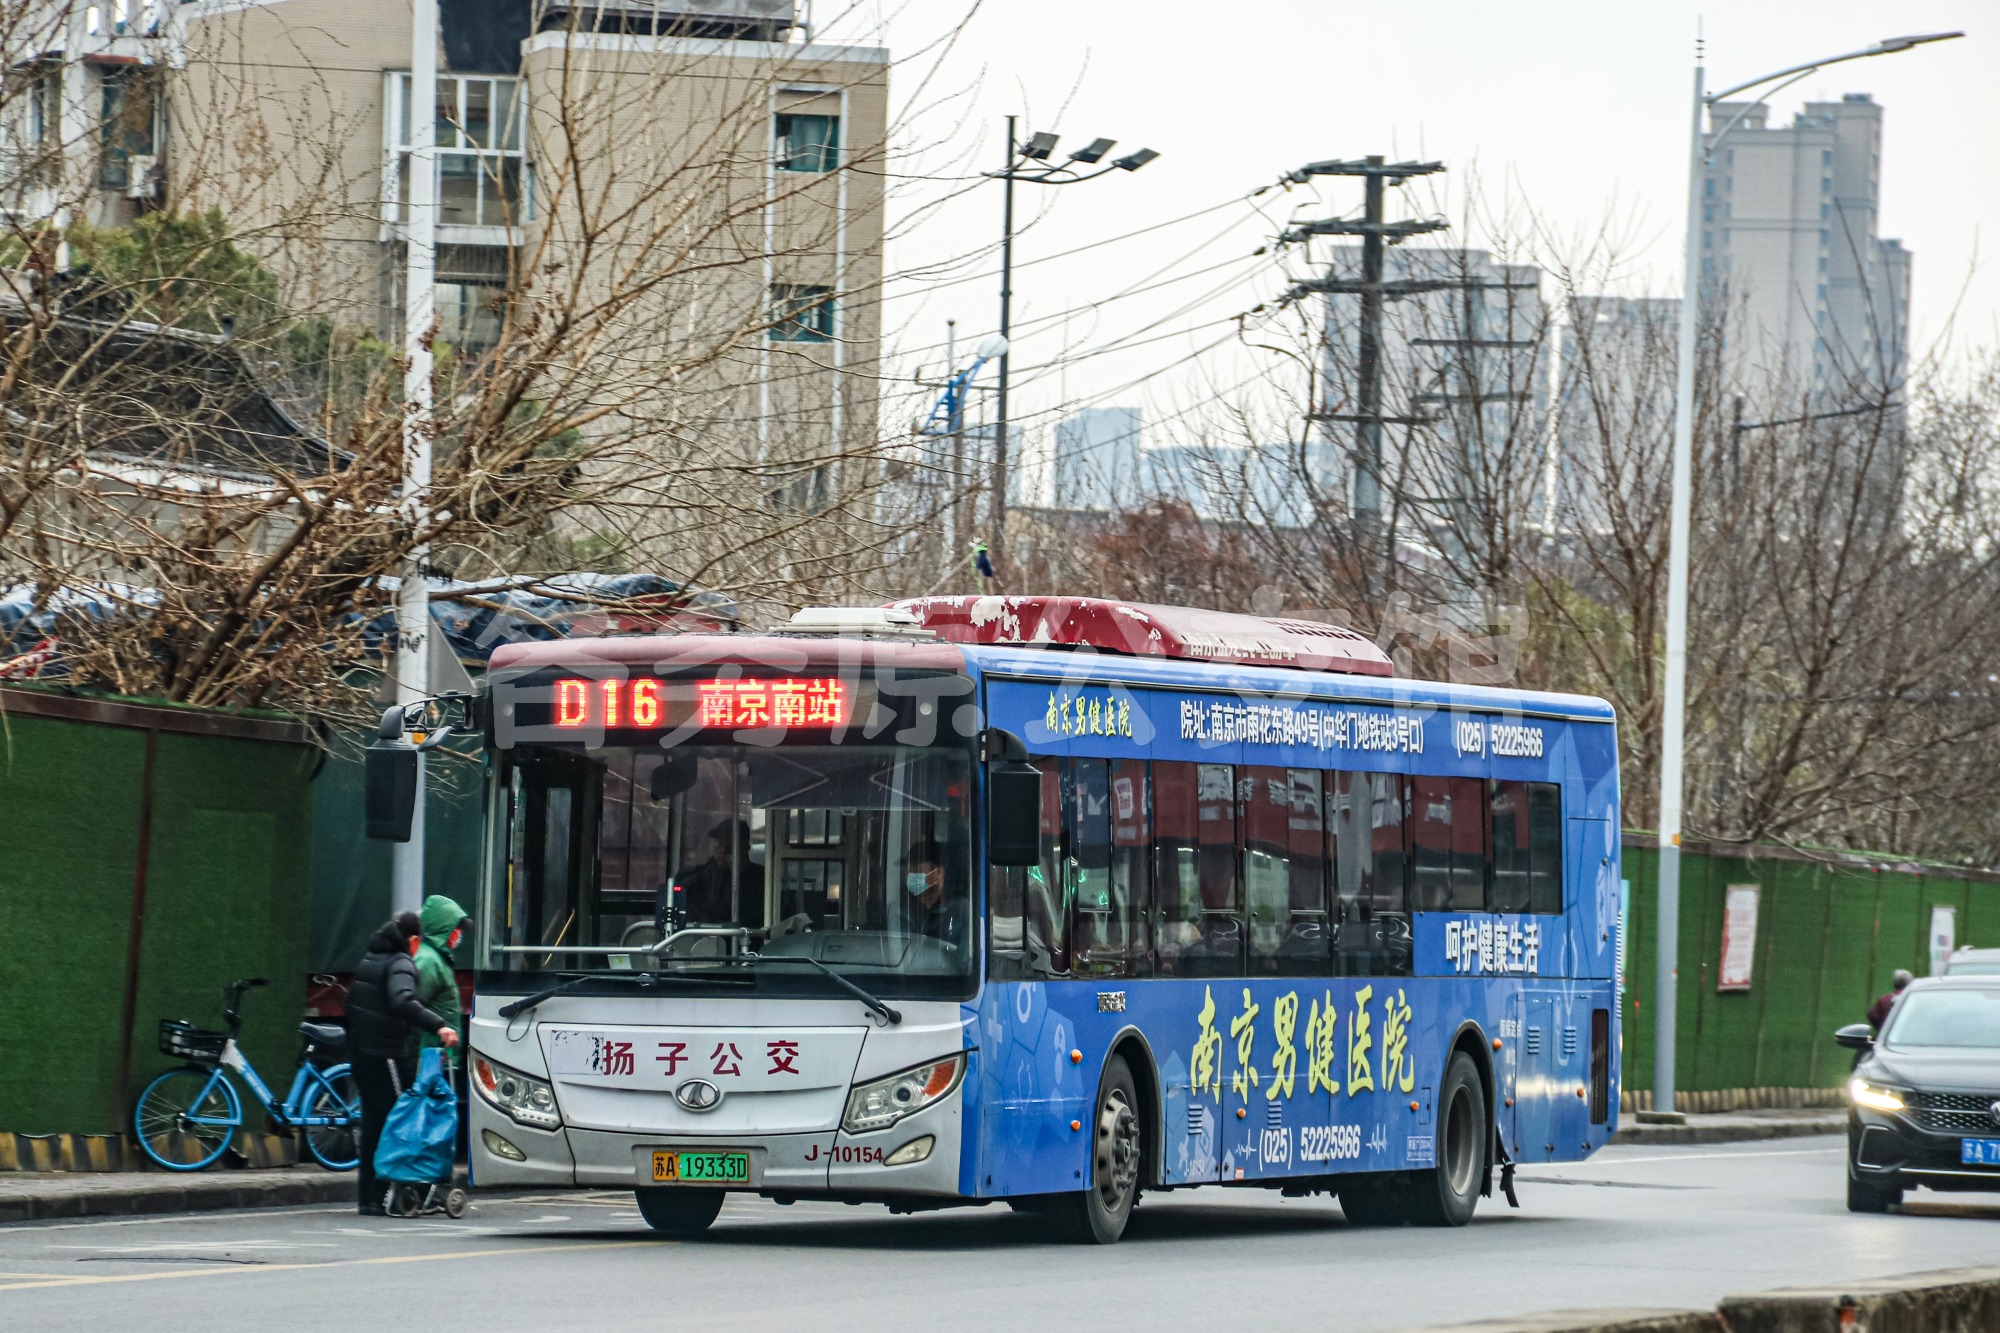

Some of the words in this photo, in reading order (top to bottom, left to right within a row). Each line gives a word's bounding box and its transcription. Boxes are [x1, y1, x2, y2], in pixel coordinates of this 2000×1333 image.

[559, 679, 658, 727] D16
[699, 678, 842, 727] 南京南站
[1046, 691, 1133, 738] 南京男健医院
[1457, 721, 1486, 759] (025)
[1491, 724, 1543, 757] 52225966
[1446, 919, 1539, 974] 呵护健康生活
[603, 1040, 800, 1077] 扬子公交
[1190, 984, 1415, 1104] 南京男健医院
[804, 1145, 883, 1164] J-10154
[1258, 1127, 1293, 1172] (025)
[1300, 1124, 1361, 1161] 52225966
